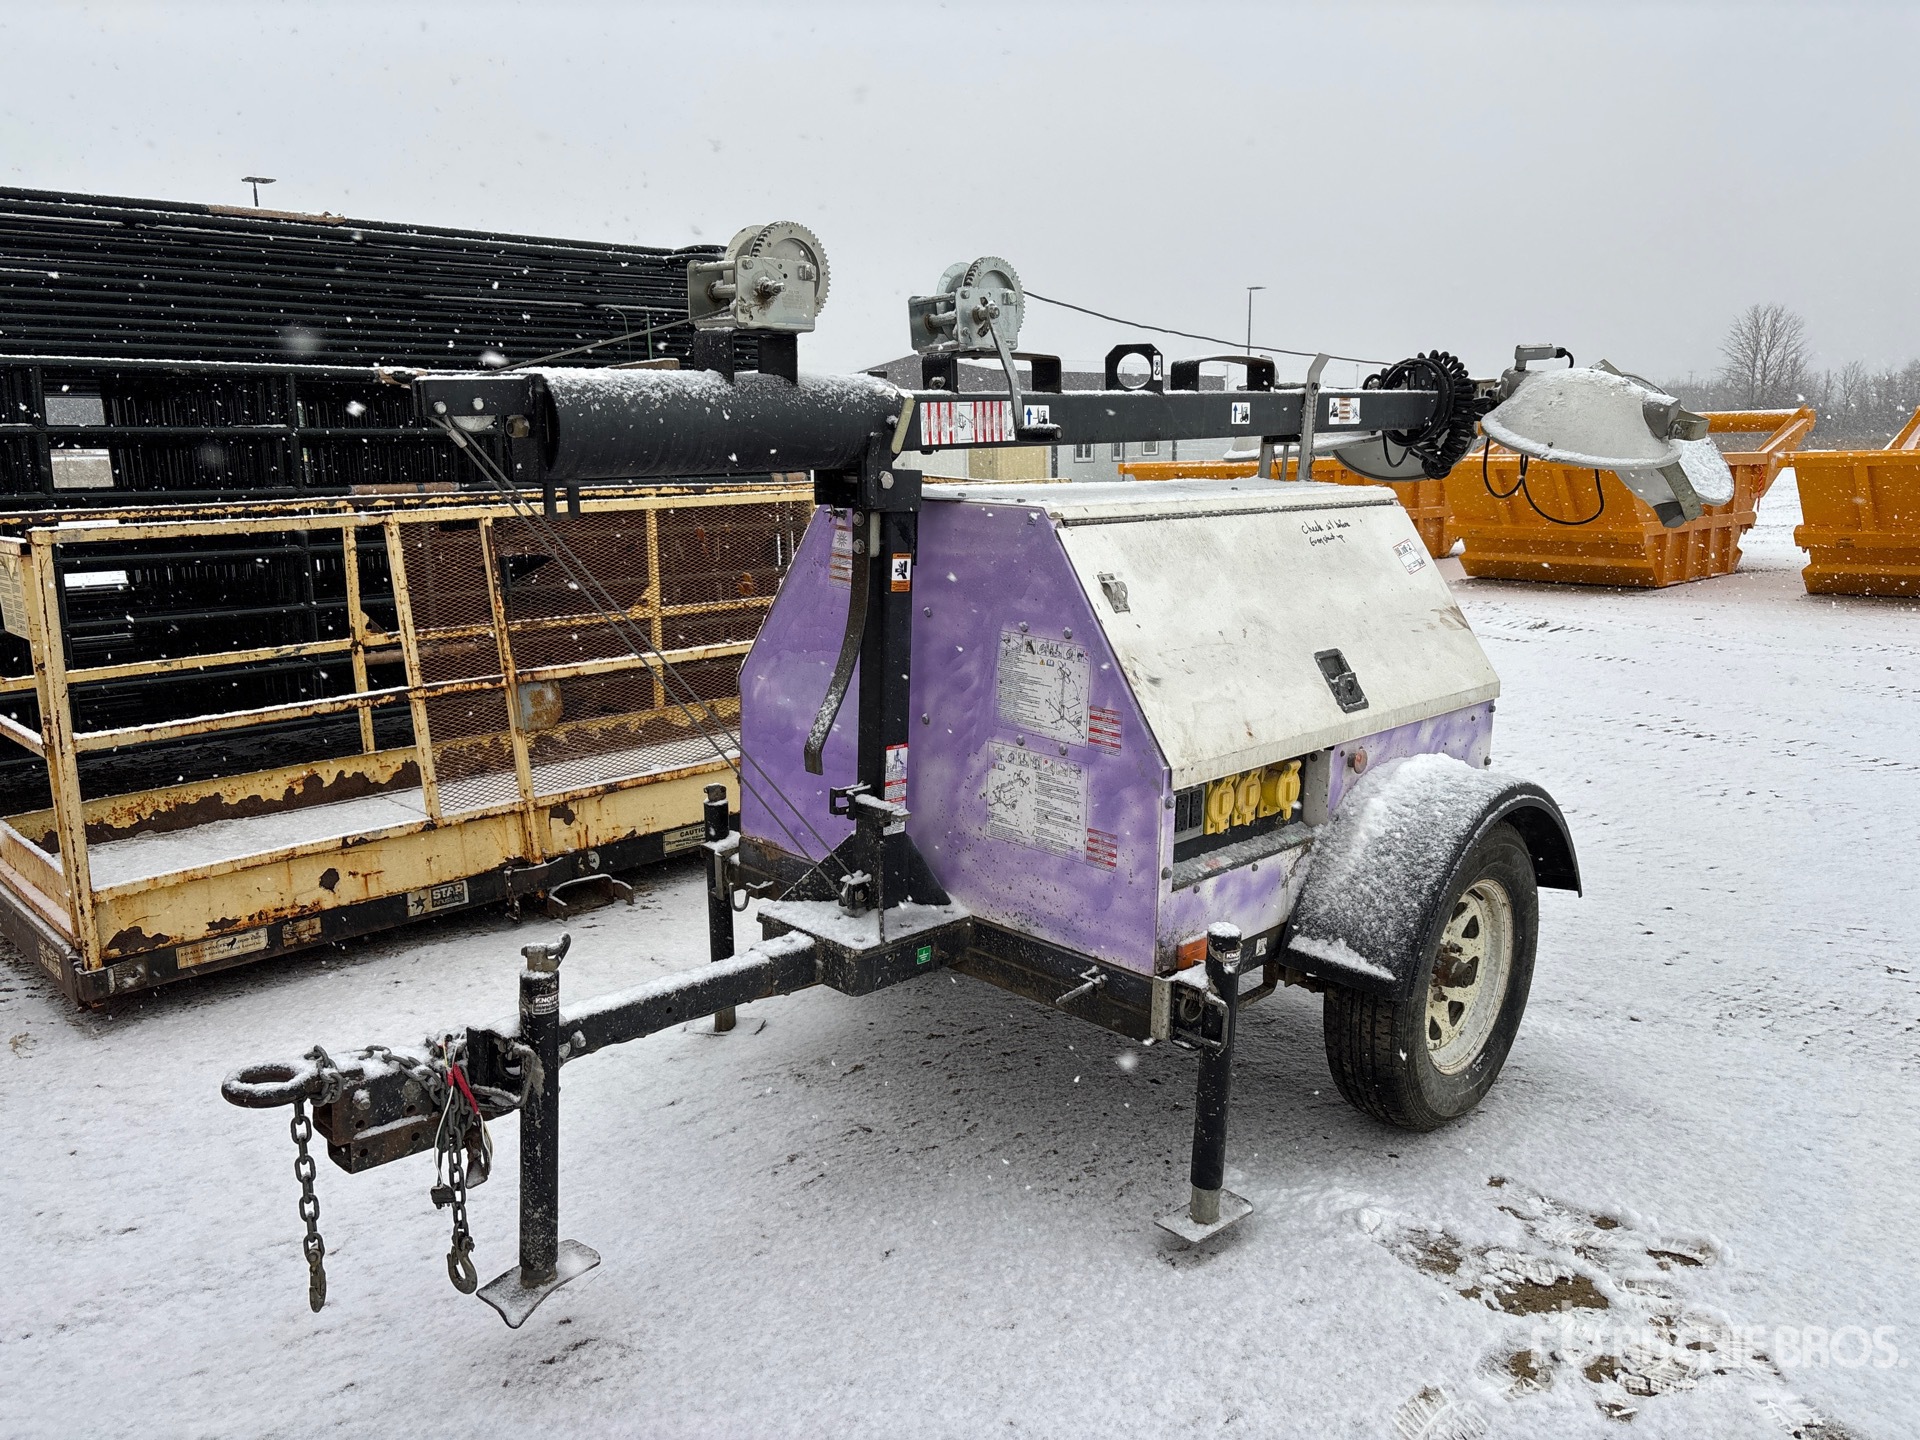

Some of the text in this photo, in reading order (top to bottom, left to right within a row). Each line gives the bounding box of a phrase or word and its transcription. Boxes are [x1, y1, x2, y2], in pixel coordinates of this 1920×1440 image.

[679, 826, 706, 838] CAUTIO
[432, 883, 464, 900] STAR
[1226, 951, 1240, 960] KNO
[535, 994, 558, 1004] KNOTT
